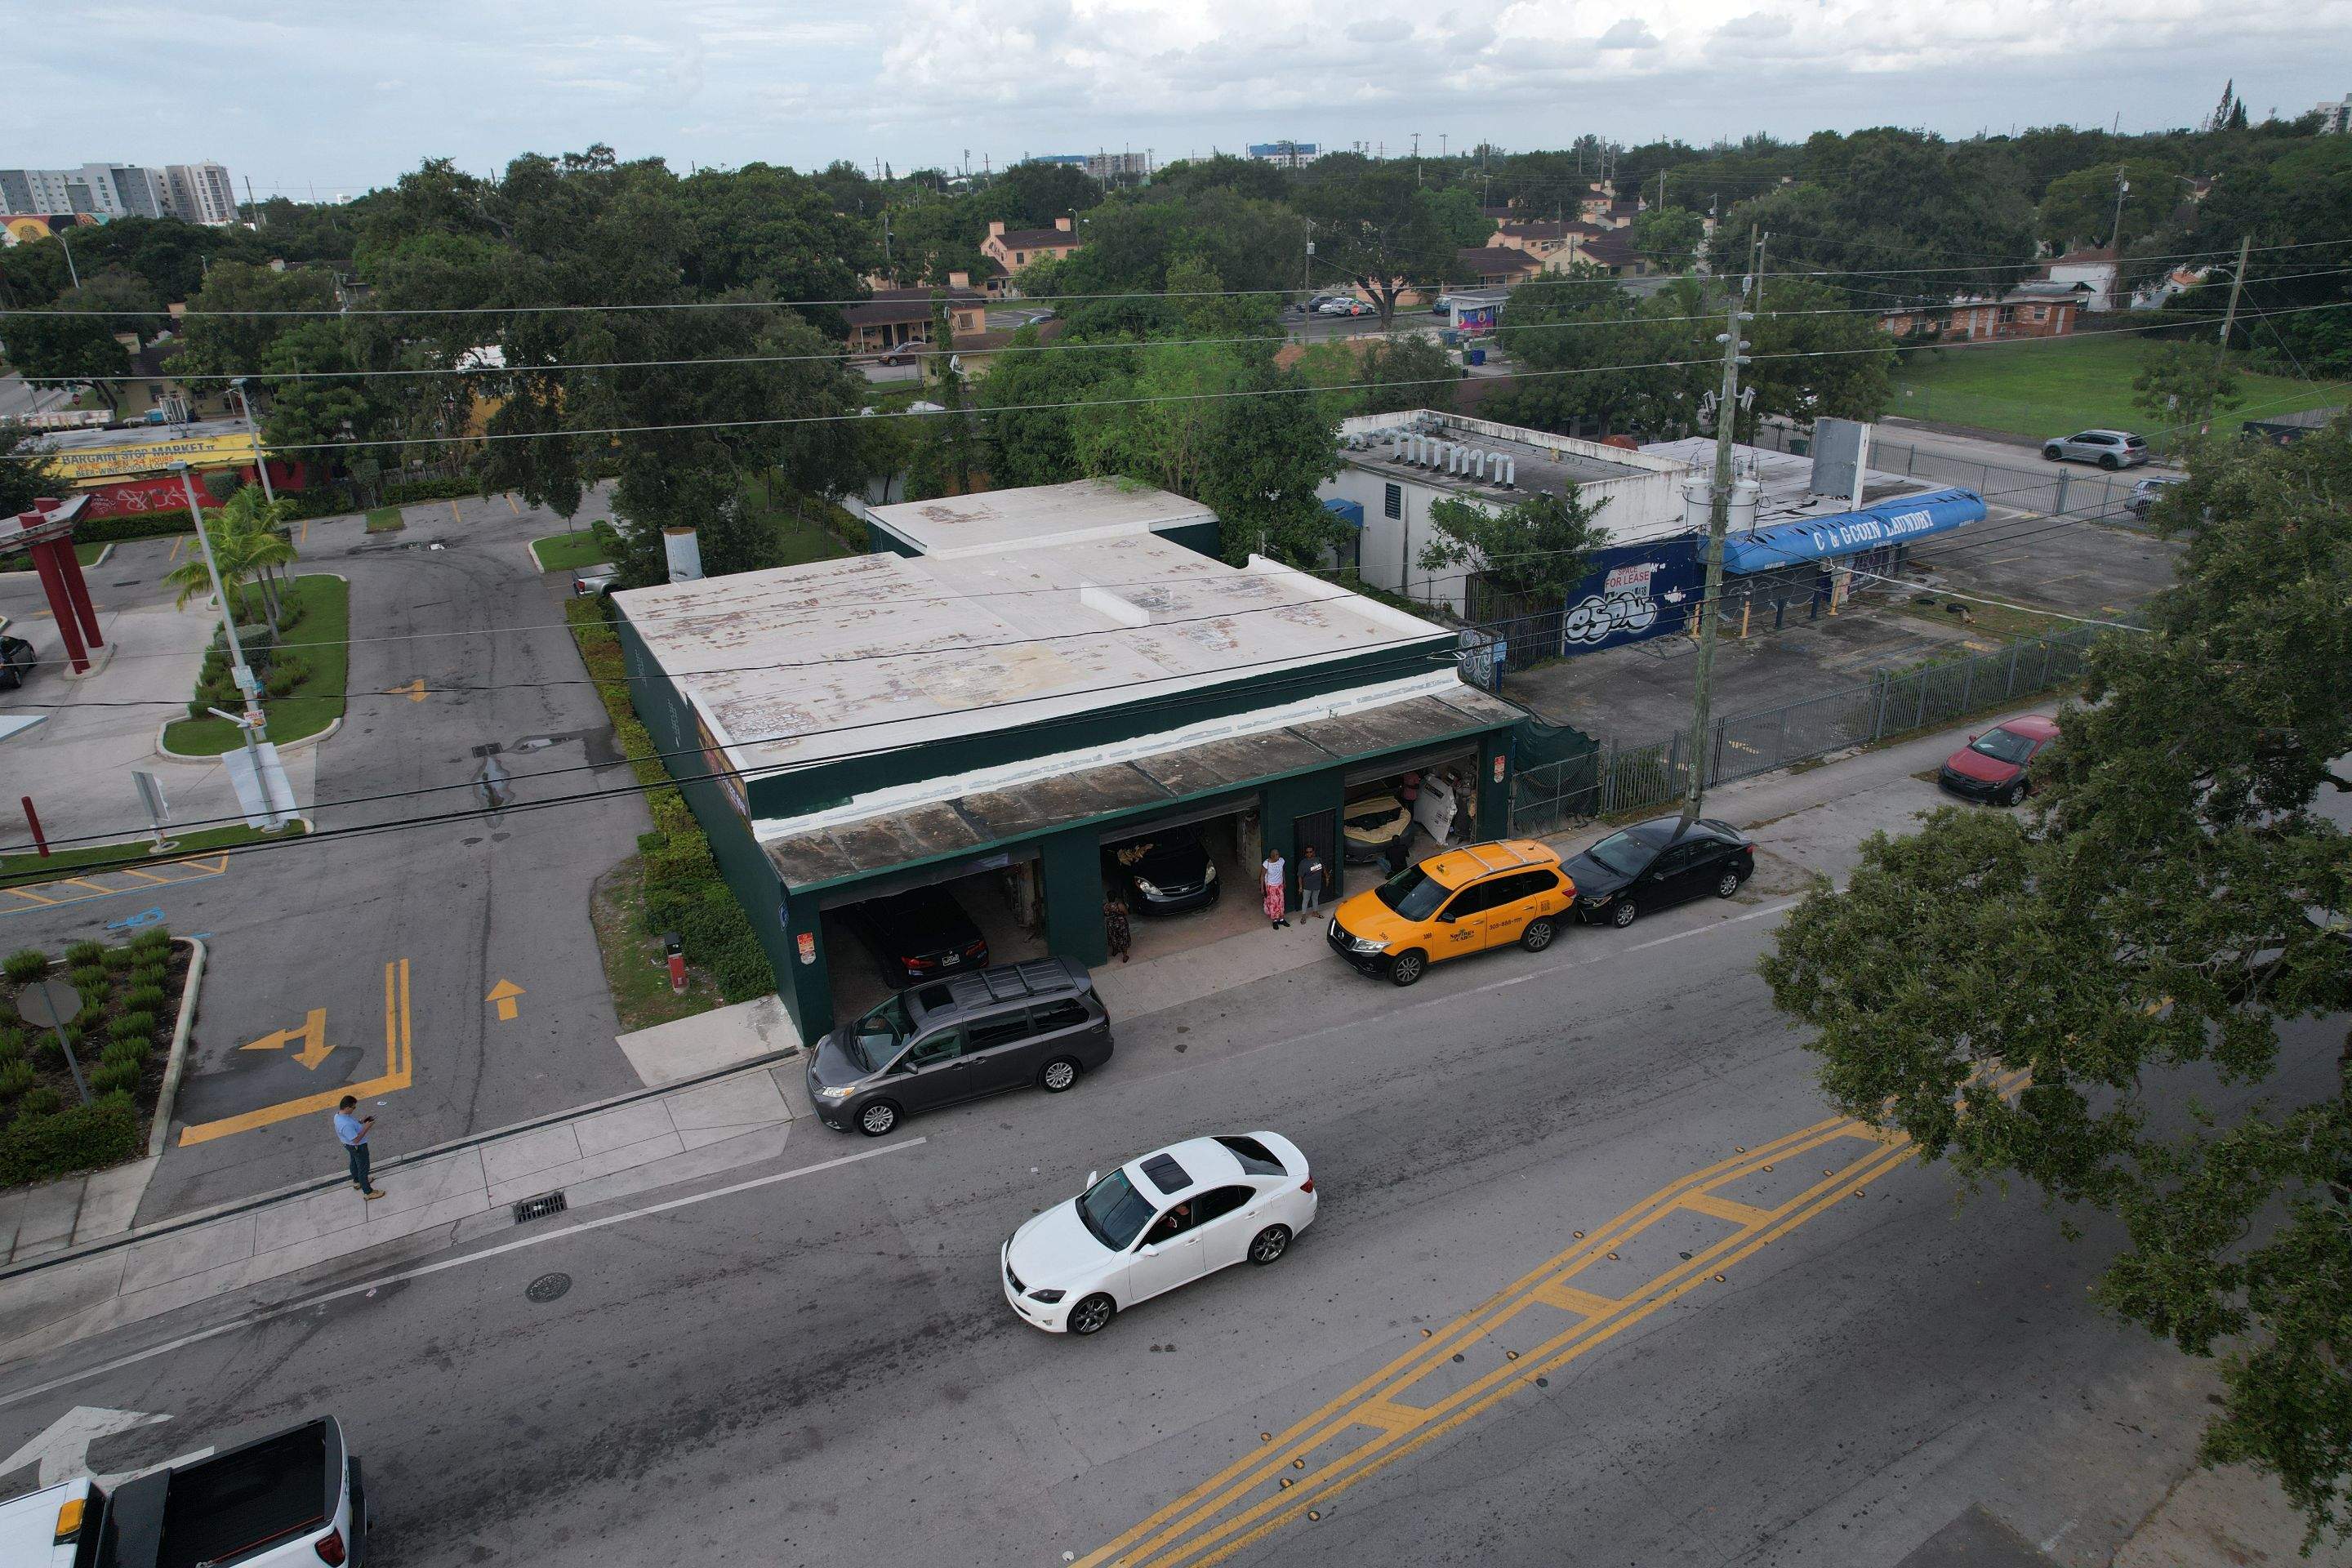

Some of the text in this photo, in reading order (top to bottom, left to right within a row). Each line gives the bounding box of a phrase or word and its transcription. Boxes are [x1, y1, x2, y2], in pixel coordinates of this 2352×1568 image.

[62, 452, 118, 465] BARGAIN
[122, 448, 147, 460] STOP
[152, 443, 204, 457] MARKET
[109, 460, 130, 468] OPEN
[149, 456, 174, 464] HOURS
[1813, 532, 1825, 551] C
[1828, 530, 1840, 549] &
[1883, 510, 1934, 537] LAUNDRY
[1617, 565, 1638, 576] SPACE
[1605, 571, 1650, 588] FOR LEASE
